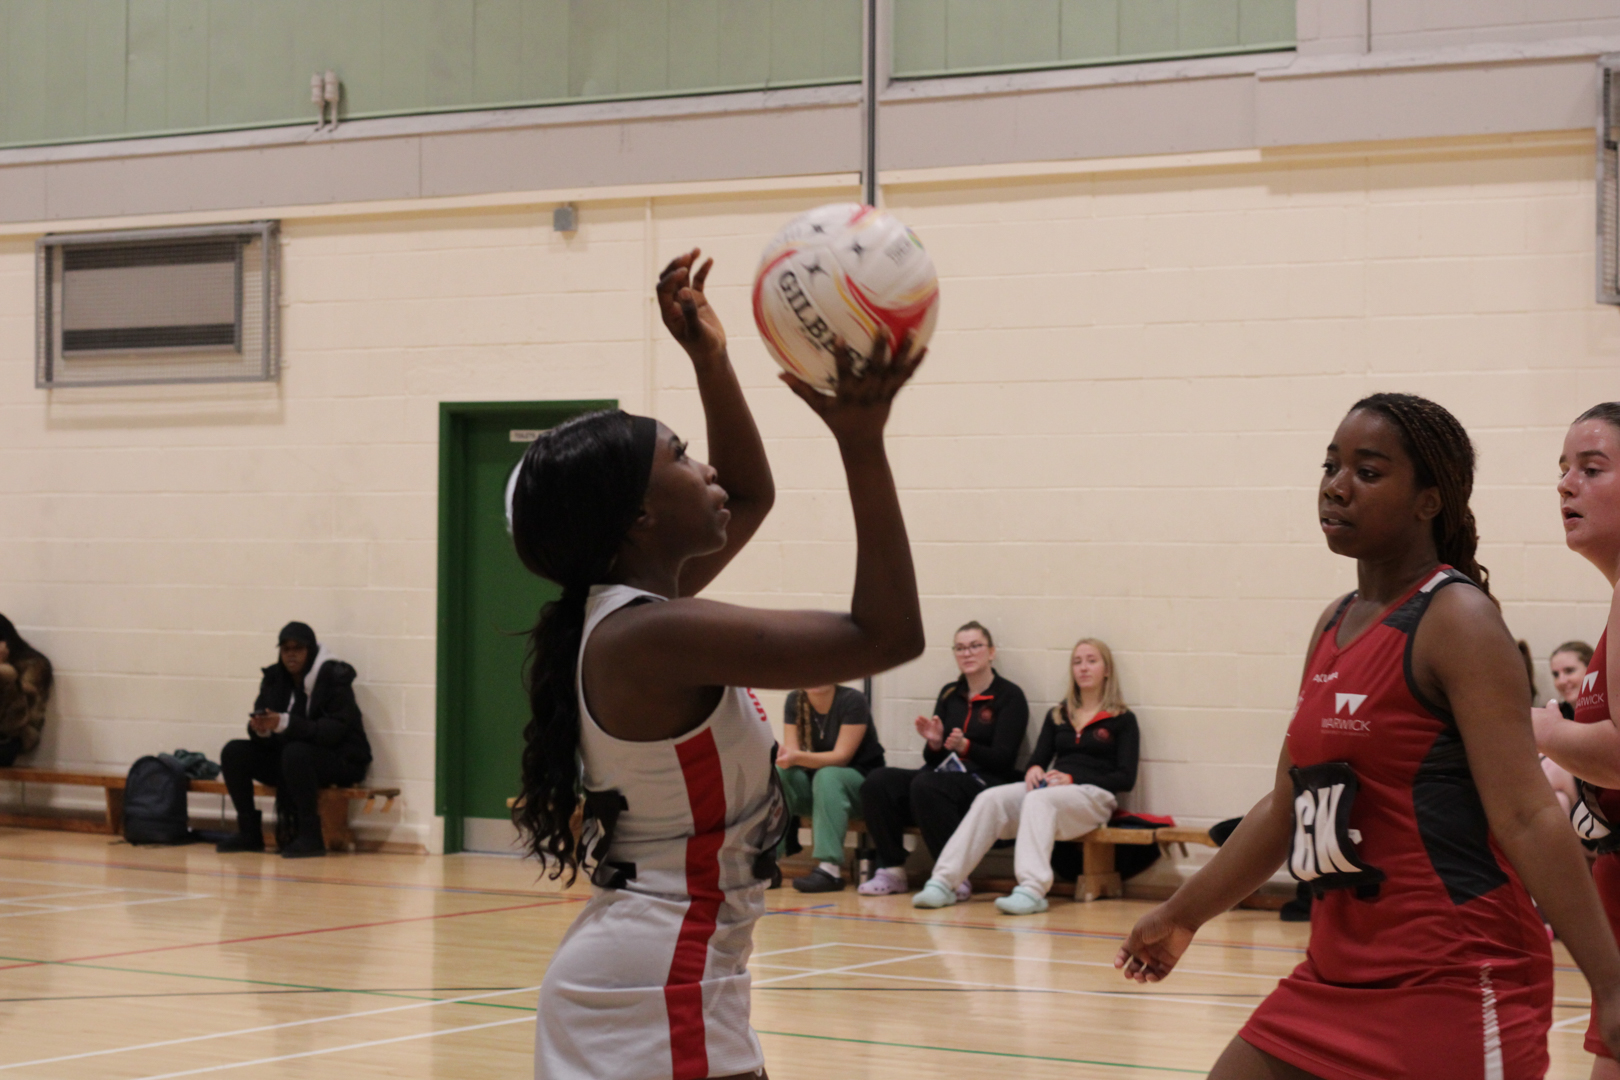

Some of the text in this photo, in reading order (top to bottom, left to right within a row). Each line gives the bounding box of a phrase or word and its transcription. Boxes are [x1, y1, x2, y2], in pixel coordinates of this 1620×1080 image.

[778, 270, 868, 369] GILBE
[1321, 717, 1371, 732] WARWICK
[1576, 693, 1605, 709] ARWICK
[1290, 783, 1364, 882] GK
